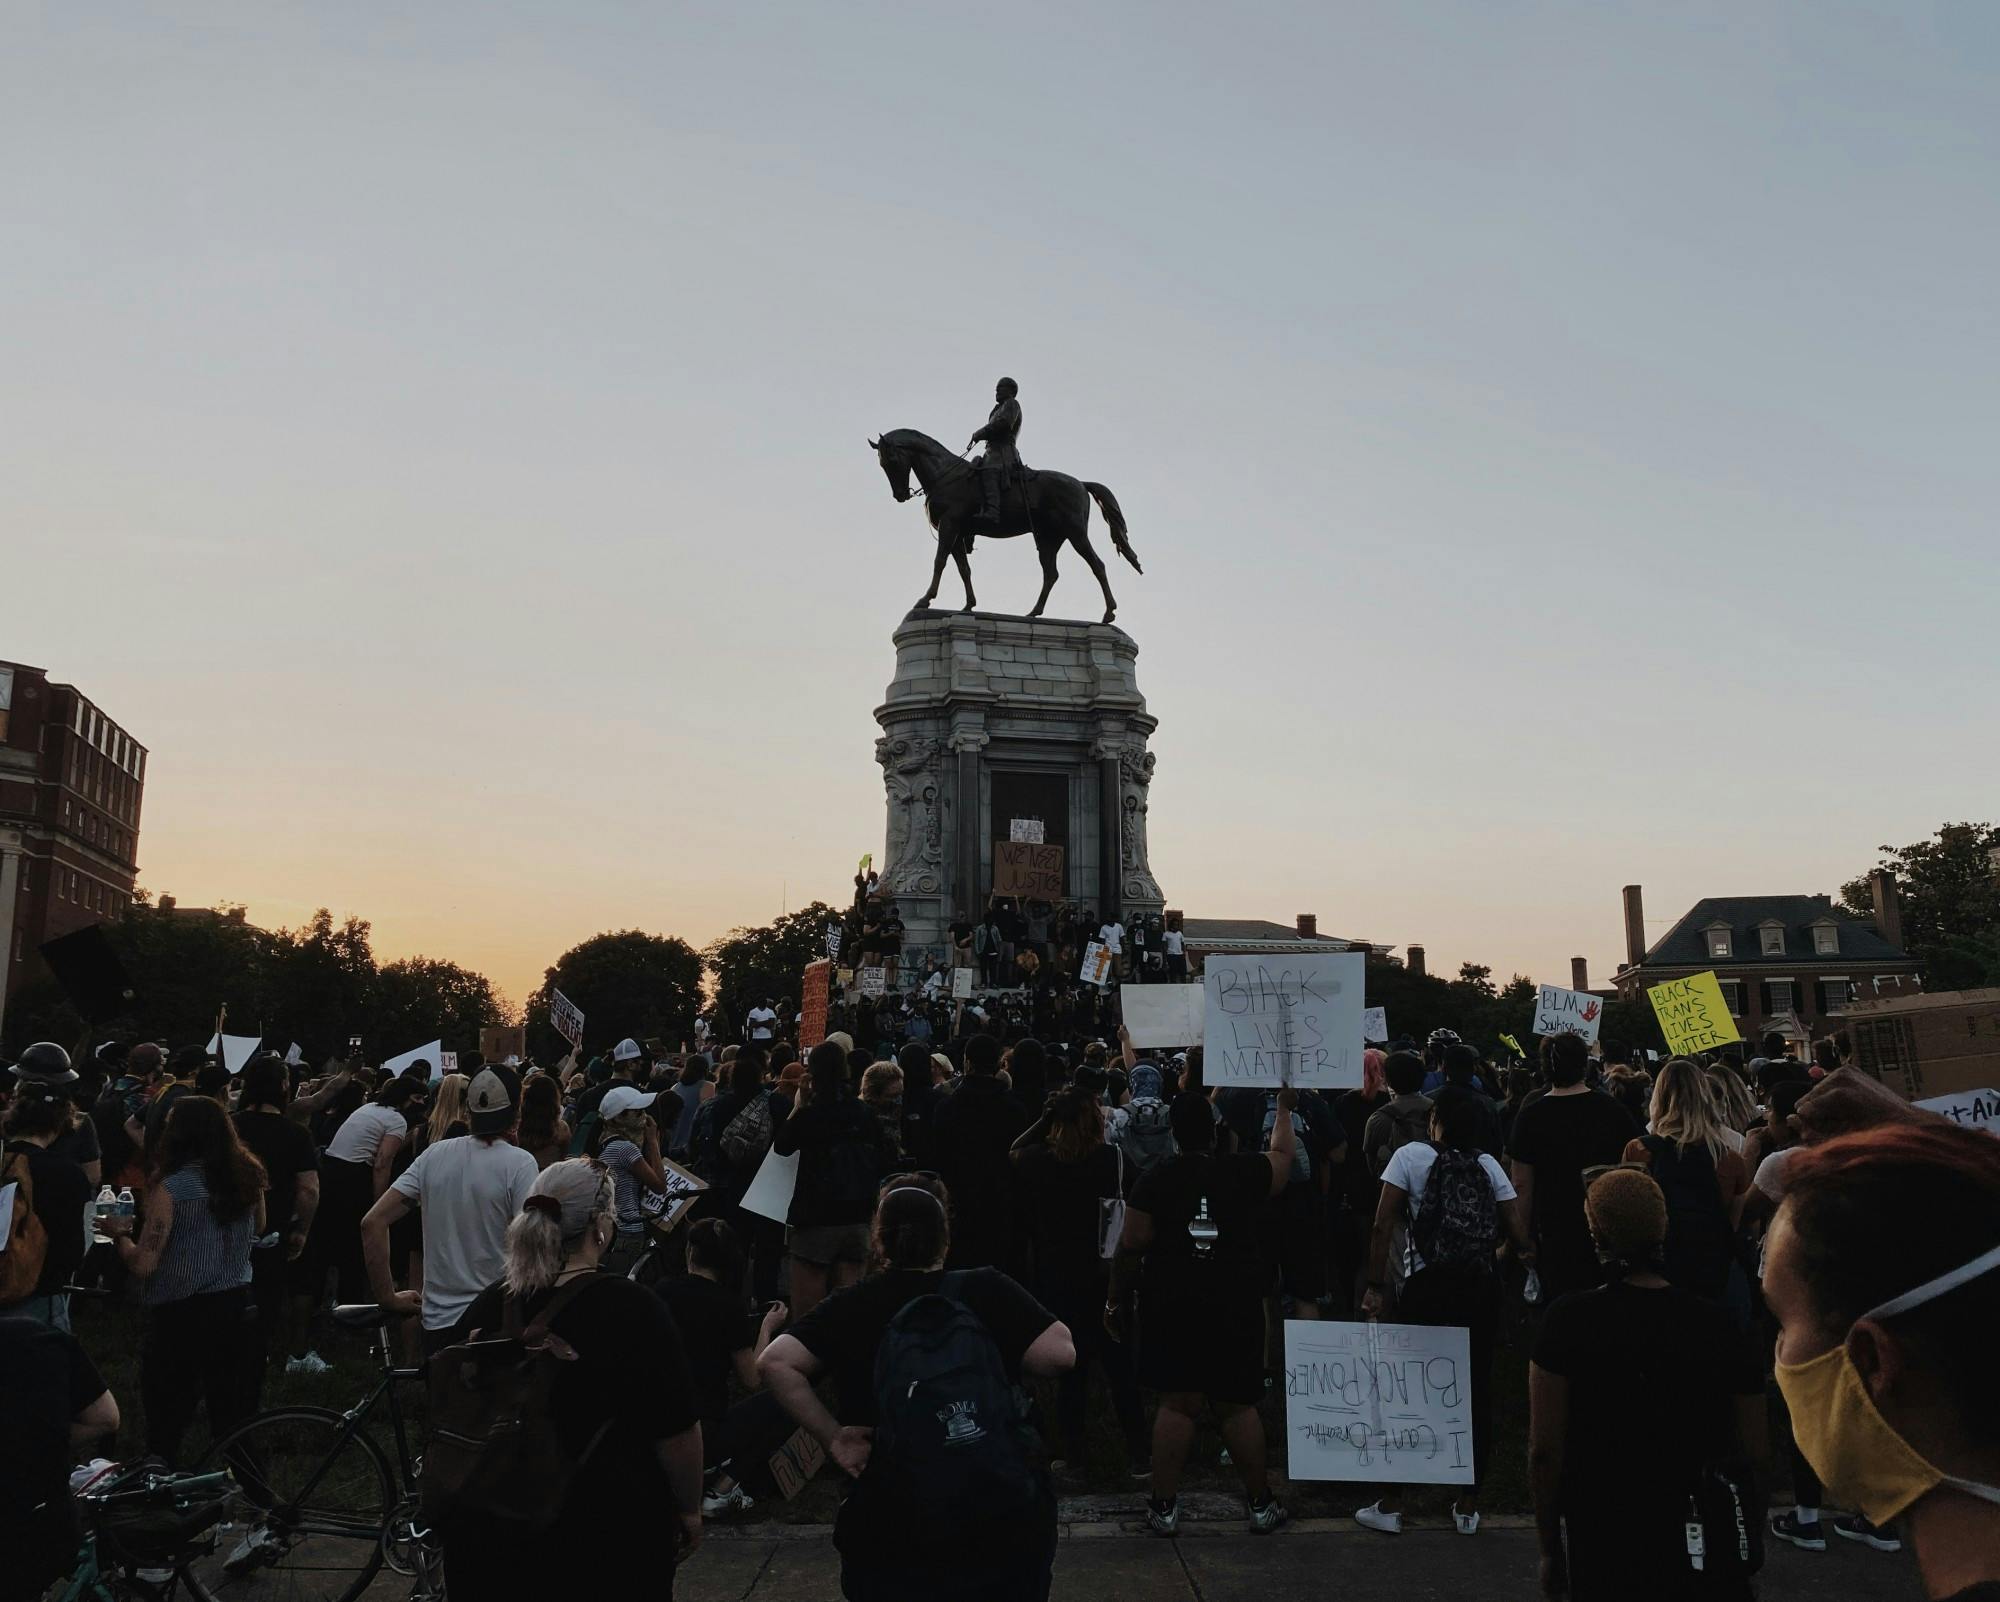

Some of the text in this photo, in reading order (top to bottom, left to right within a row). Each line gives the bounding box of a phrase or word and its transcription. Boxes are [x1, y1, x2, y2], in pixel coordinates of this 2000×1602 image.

[1029, 845, 1062, 872] NEED
[1541, 990, 1578, 1015] BLM
[1653, 979, 1703, 1005] BLACK
[1658, 997, 1706, 1021] TRANS
[1231, 1015, 1324, 1050] LIVES
[1666, 1012, 1714, 1040] LIVES
[1672, 1030, 1729, 1056] MATTER
[1286, 1356, 1462, 1408] BLACK POWER
[1449, 1431, 1468, 1468] I
